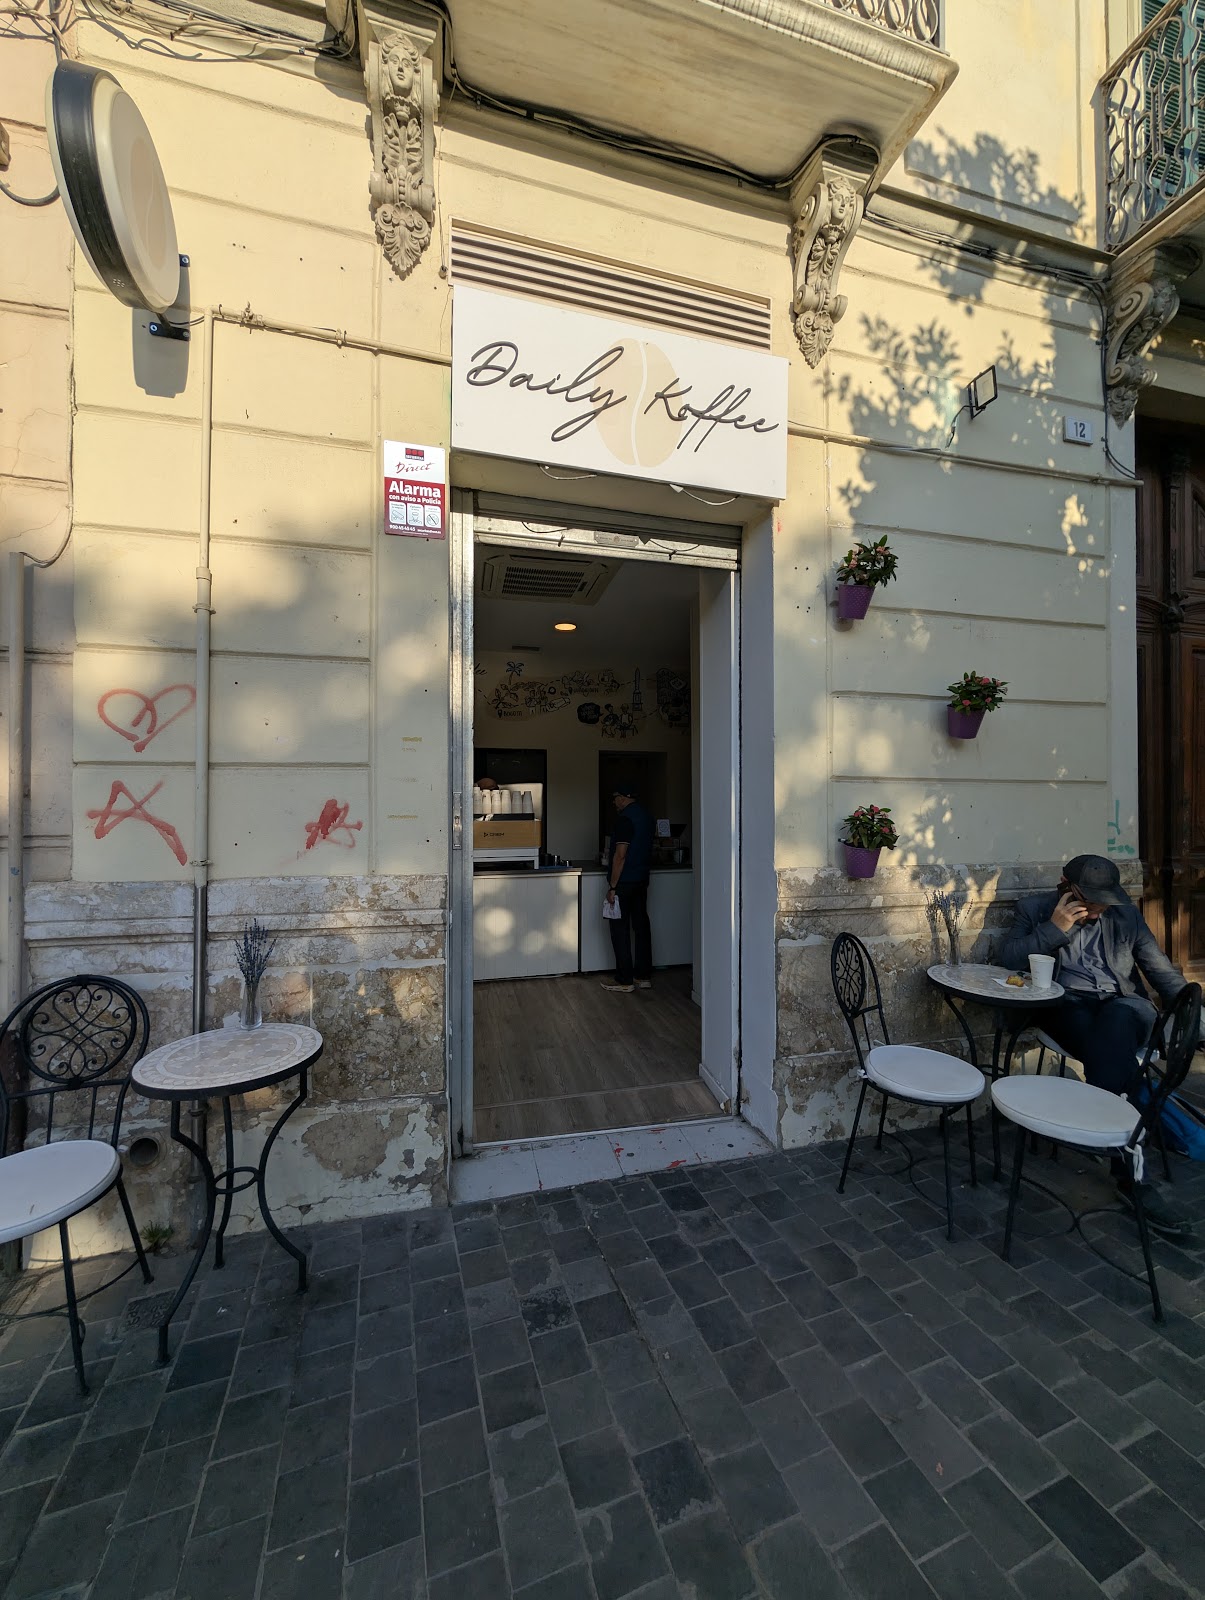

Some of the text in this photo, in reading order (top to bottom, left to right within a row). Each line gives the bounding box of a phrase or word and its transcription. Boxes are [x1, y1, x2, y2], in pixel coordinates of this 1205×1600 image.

[466, 341, 779, 452] Daily Koffee
[1074, 422, 1085, 438] 12
[395, 462, 436, 474] Direct
[389, 481, 441, 498] Alarma
